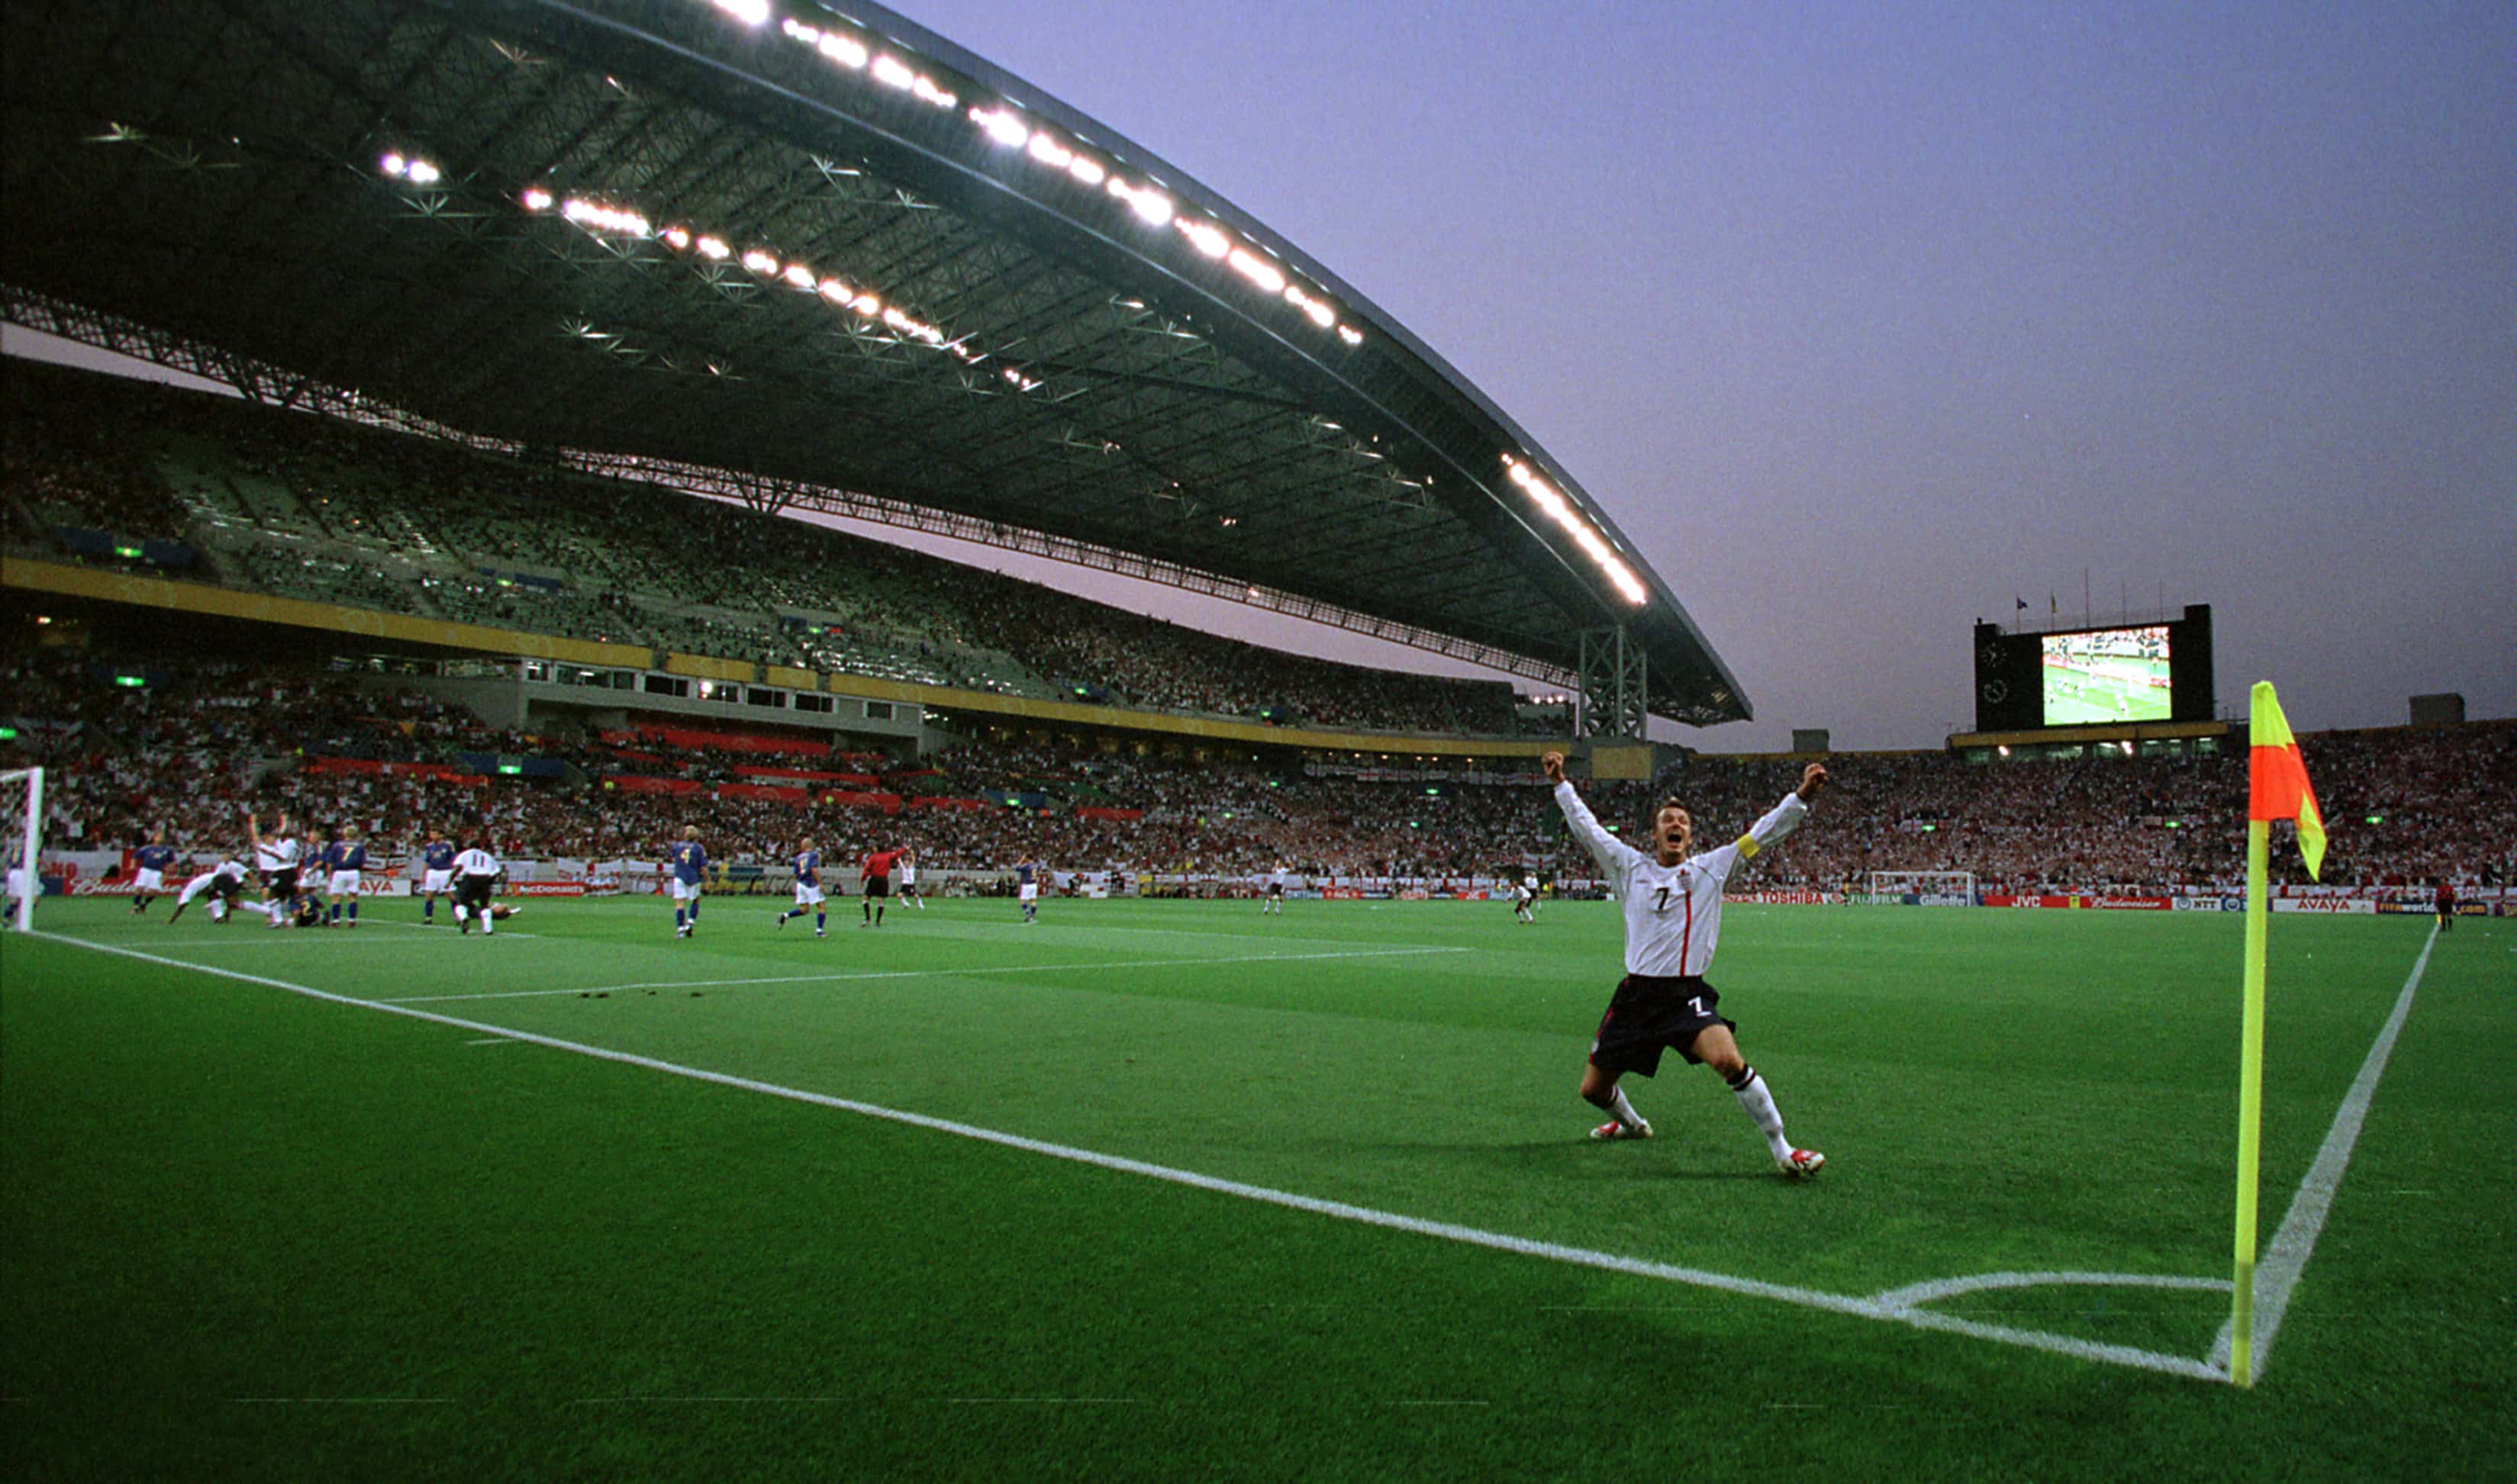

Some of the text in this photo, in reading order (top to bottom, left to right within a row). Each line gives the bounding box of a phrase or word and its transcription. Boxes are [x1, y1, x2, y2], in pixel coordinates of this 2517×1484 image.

[342, 847, 354, 861] 7
[472, 853, 485, 868] 11
[680, 848, 691, 864] 4
[1655, 886, 1670, 910] 7
[1760, 891, 1824, 904] TOSHIBA
[1919, 895, 1966, 906] Gillette
[2011, 896, 2041, 907] JVC
[2090, 896, 2161, 909] Budweiser
[2193, 900, 2216, 909] NTT
[2297, 900, 2351, 913] AVAYA
